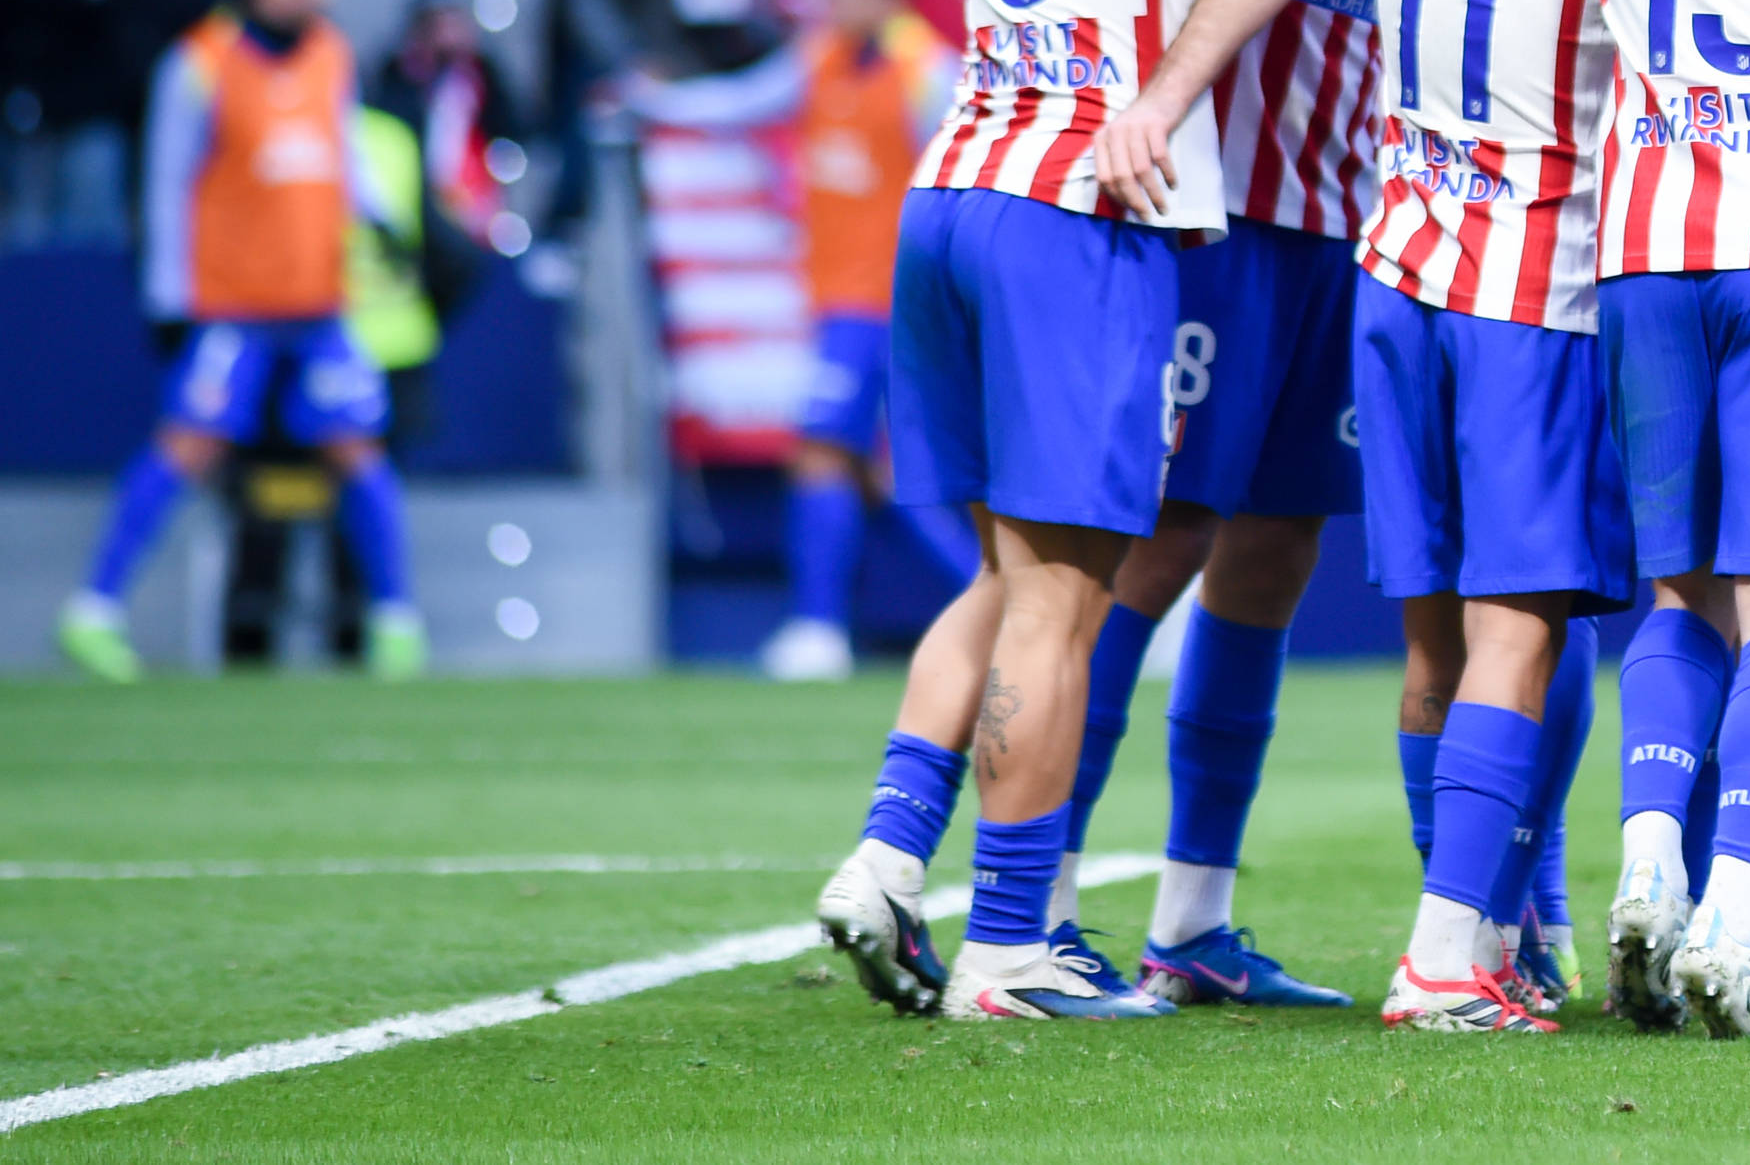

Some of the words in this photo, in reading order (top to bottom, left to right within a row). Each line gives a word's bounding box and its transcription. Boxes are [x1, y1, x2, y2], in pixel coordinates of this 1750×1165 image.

[994, 22, 1078, 57] VISIT
[1403, 127, 1478, 167] VISIT
[1629, 743, 1697, 774] ATLETI
